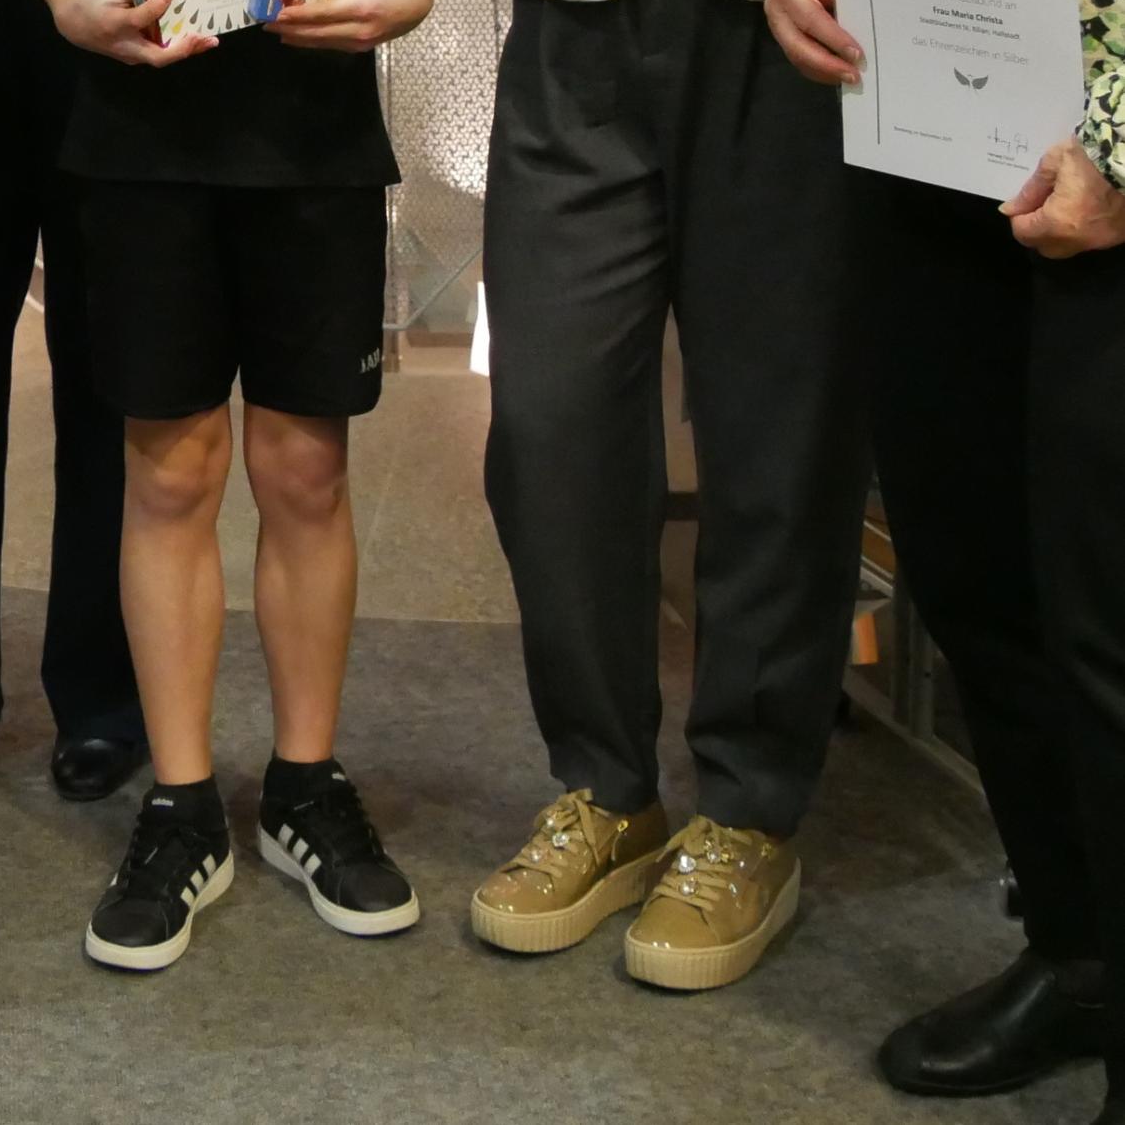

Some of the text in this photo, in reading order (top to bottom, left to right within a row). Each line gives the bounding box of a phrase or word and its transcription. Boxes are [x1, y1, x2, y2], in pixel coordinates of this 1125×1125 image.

[933, 5, 1003, 25] Frau Maria Christa
[911, 35, 928, 46] das
[930, 38, 990, 56] Ehrenzeichen
[1003, 52, 1029, 65] Silber
